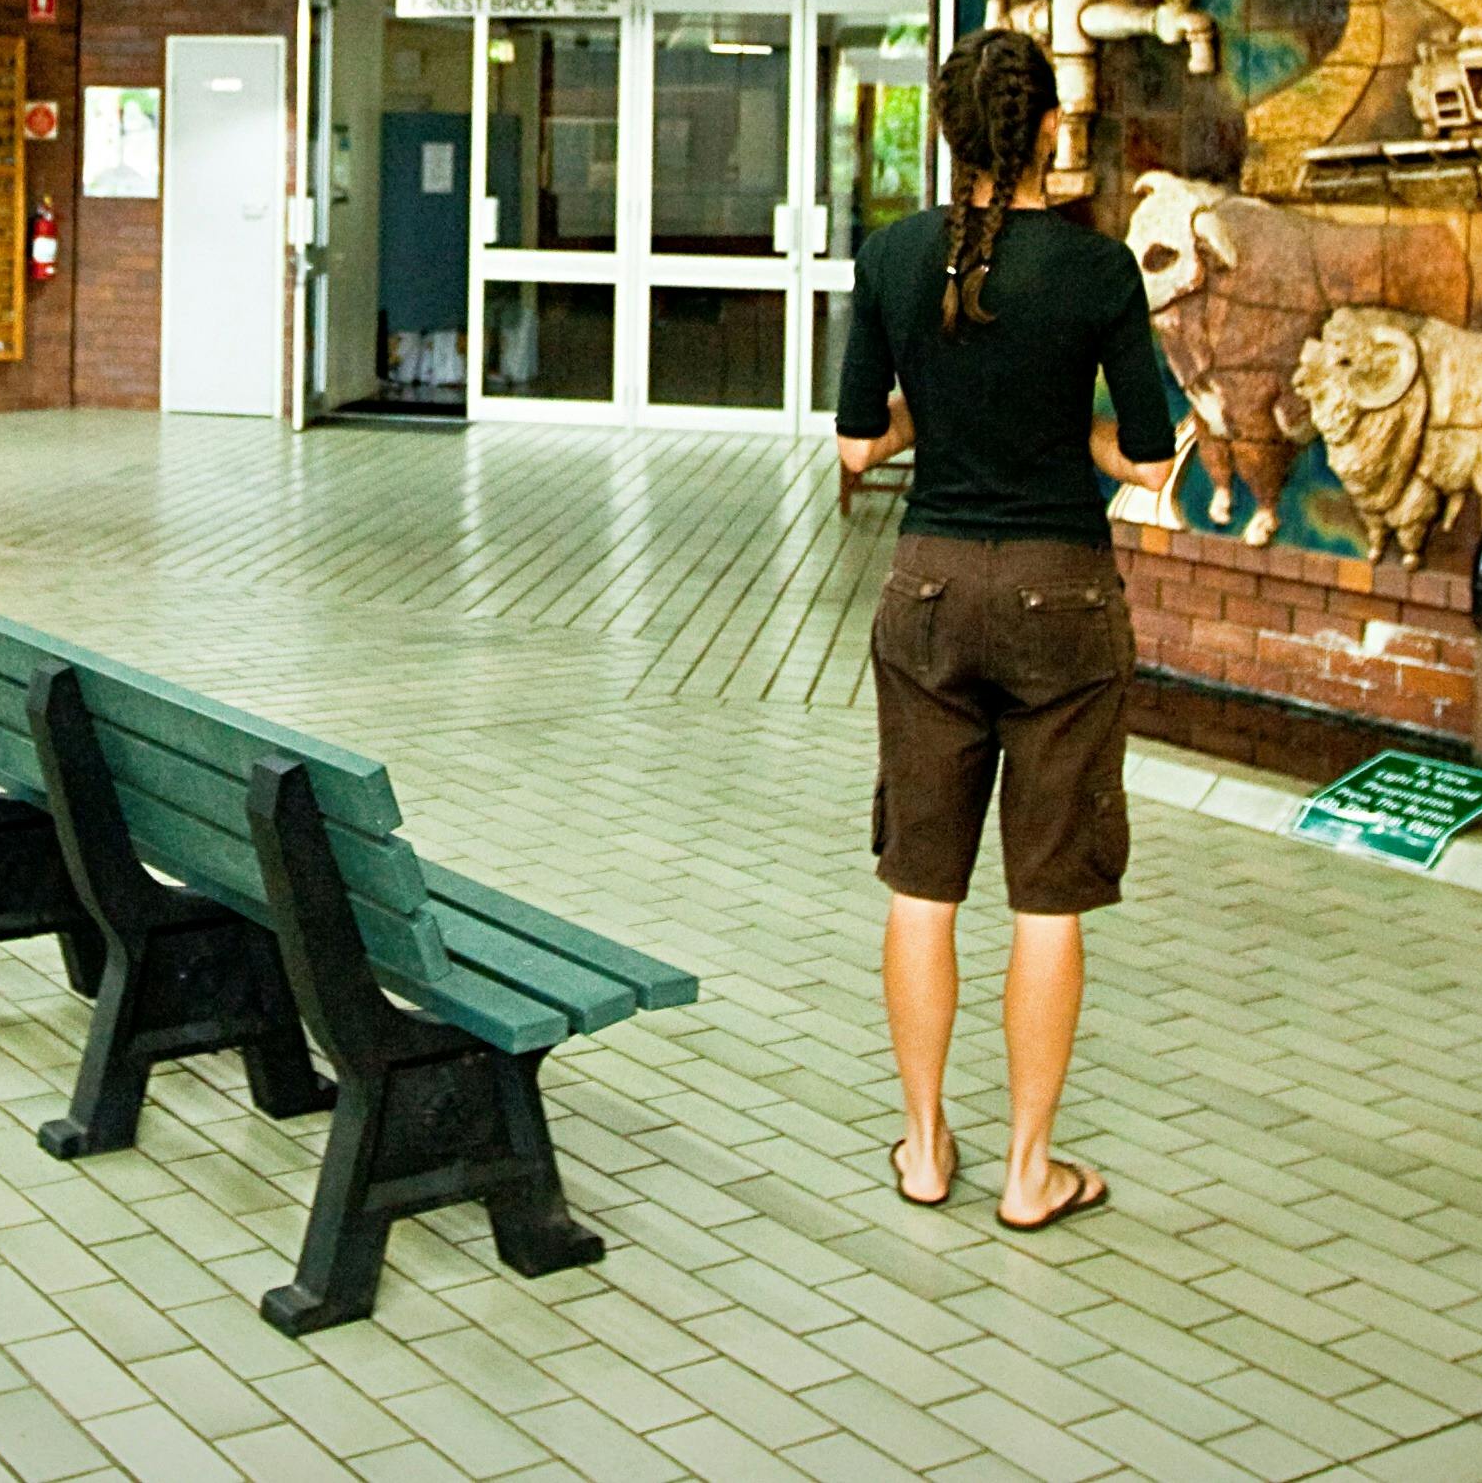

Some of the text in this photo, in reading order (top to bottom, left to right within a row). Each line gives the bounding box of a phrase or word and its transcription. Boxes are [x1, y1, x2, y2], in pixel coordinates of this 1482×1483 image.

[1415, 765, 1432, 777] To
[1374, 769, 1414, 785] Light
[1432, 782, 1482, 802] Sound
[1335, 786, 1457, 825] Press The Button
[1406, 819, 1445, 839] Wall
